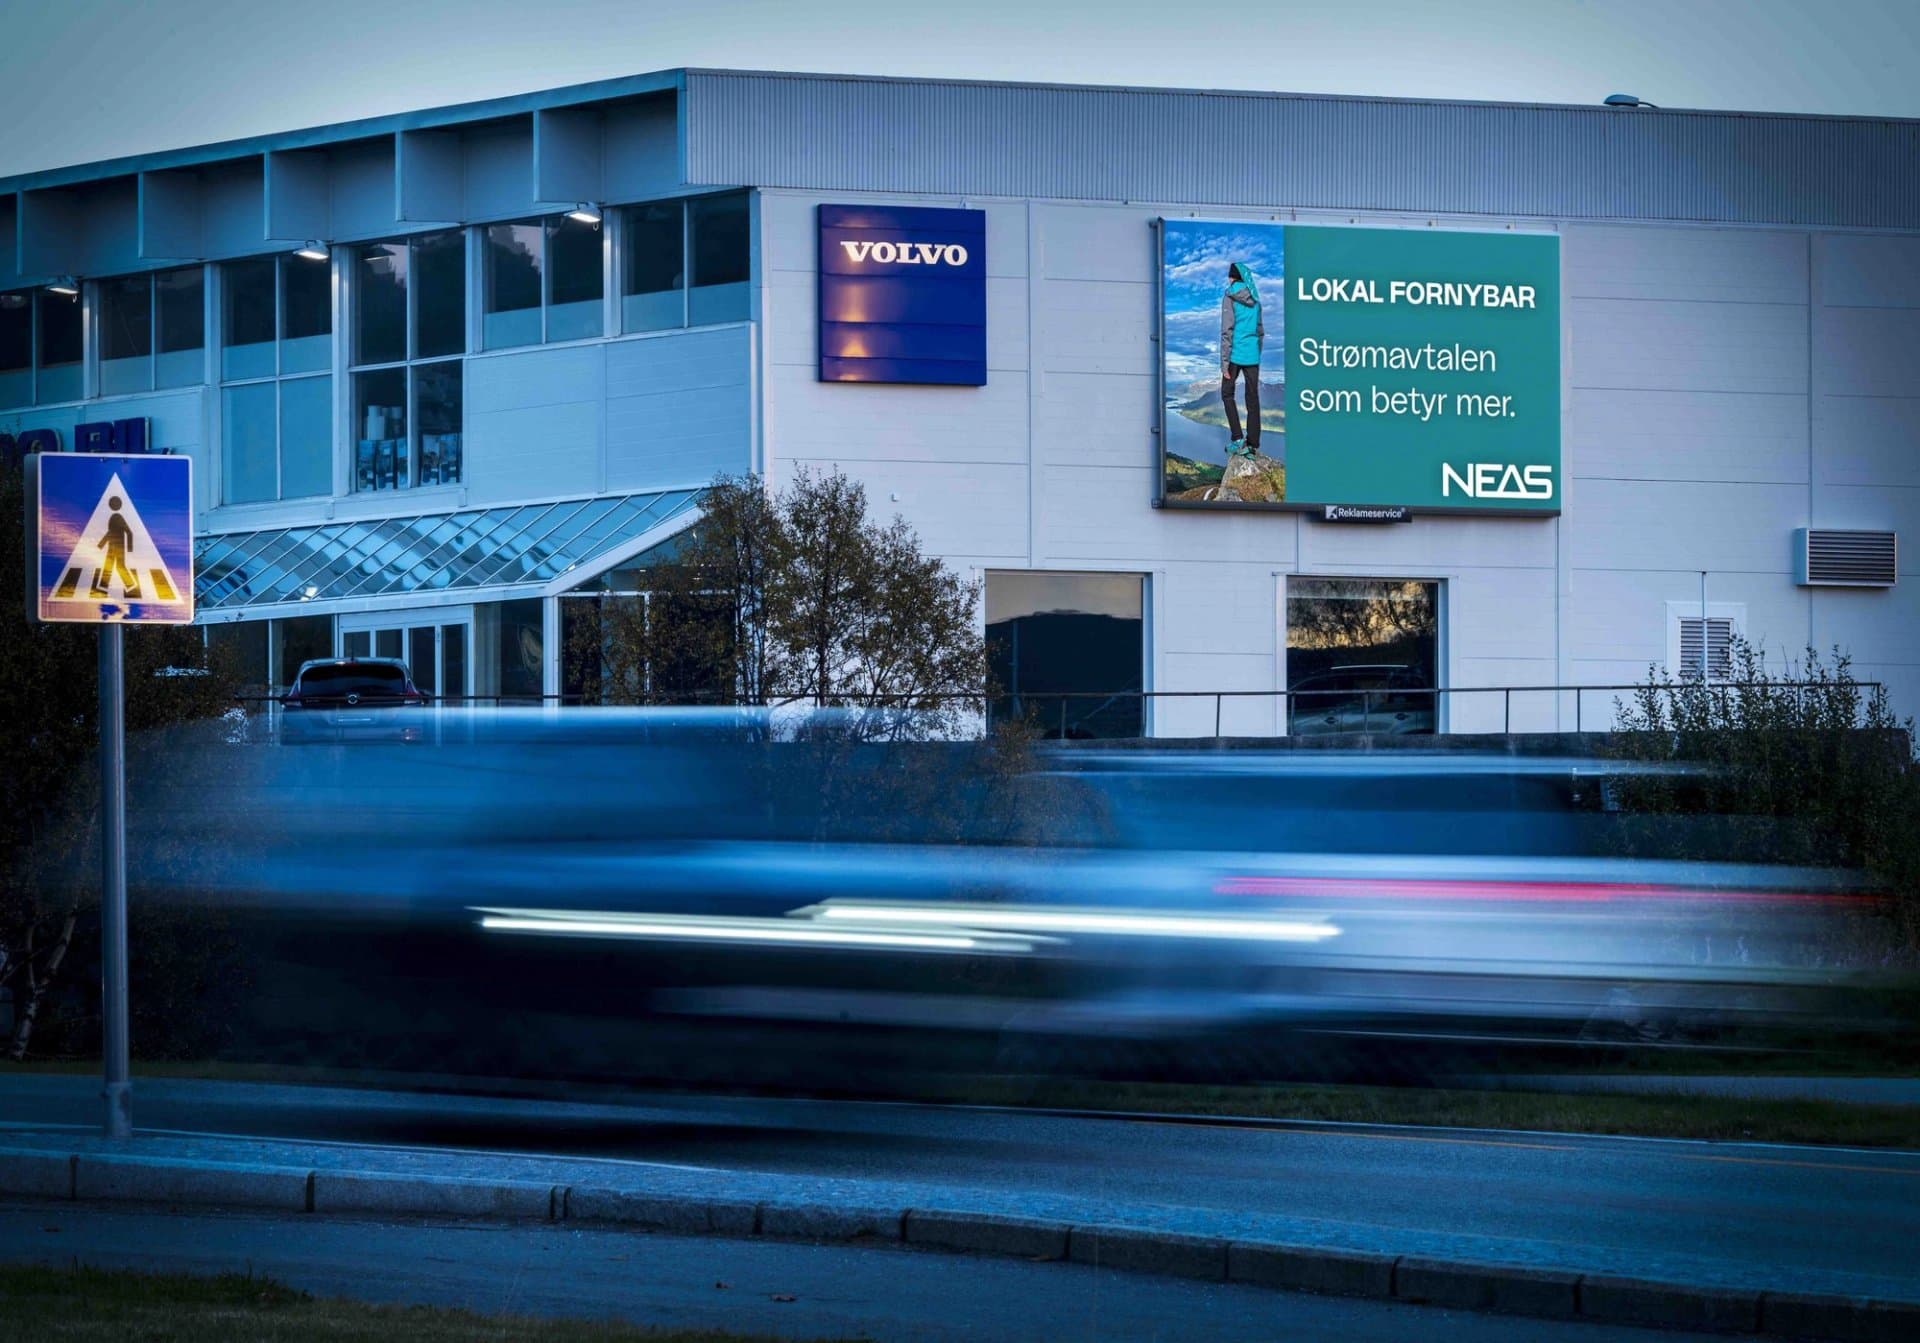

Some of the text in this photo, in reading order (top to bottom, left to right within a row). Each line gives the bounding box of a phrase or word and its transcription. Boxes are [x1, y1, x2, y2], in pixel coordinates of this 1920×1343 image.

[840, 241, 968, 266] VOLVO
[1298, 277, 1536, 309] LOKAL FORNYBAR
[1299, 337, 1496, 372] Strømavtalen
[1299, 385, 1516, 421] som betyr mer.
[1442, 462, 1553, 500] NEAS
